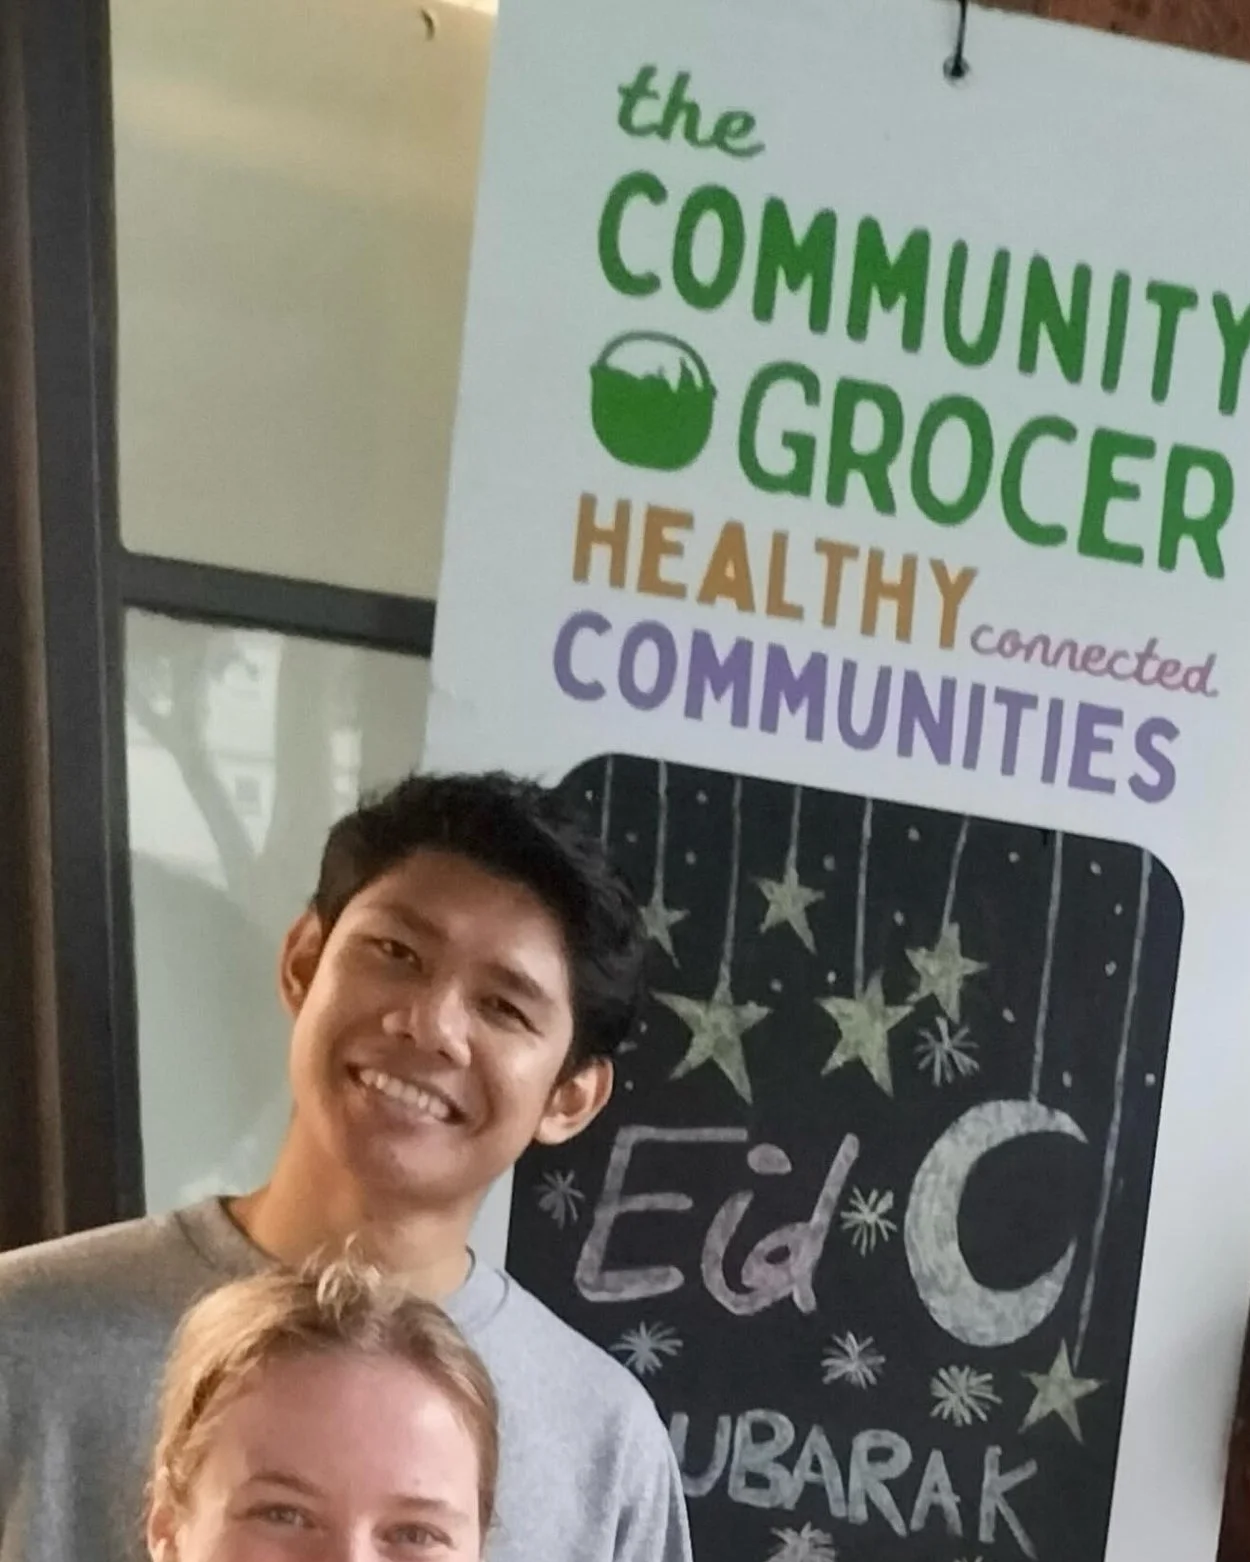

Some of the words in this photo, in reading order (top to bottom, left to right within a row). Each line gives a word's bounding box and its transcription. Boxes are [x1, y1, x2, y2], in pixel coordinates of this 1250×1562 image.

[617, 65, 764, 156] the
[738, 361, 1234, 579] GROCER
[572, 493, 979, 650] HEALTHY
[970, 623, 1218, 697] connected
[553, 610, 1180, 803] COMMUNITIES
[574, 1126, 860, 1316] Eid
